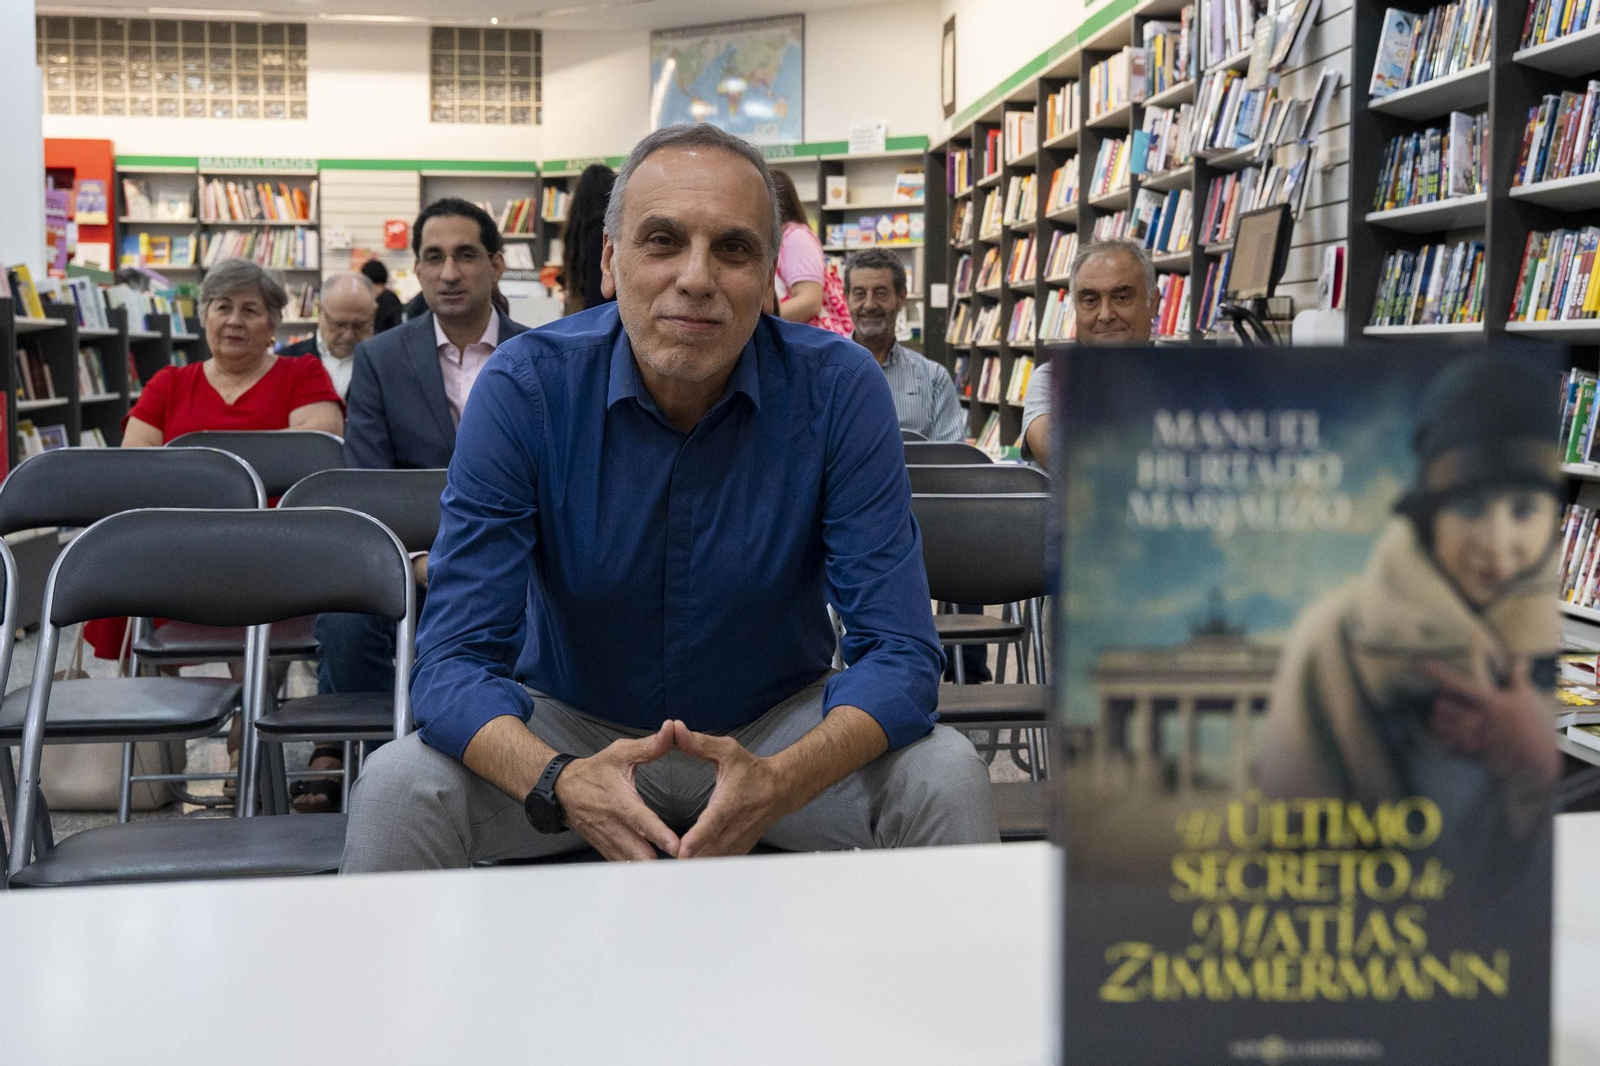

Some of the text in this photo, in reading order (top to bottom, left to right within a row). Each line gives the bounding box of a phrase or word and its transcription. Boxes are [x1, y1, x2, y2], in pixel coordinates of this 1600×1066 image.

[199, 157, 317, 170] MANUALIDADES
[1154, 408, 1322, 448] MANUEL
[1136, 452, 1343, 488] HURTADO
[1127, 491, 1351, 538] MARJALIZO
[1228, 788, 1442, 849] ÚLTIMO
[1170, 851, 1411, 902] SECRETO
[1192, 895, 1427, 960] MATÍAS
[1100, 941, 1511, 1001] ZIMMERMANN
